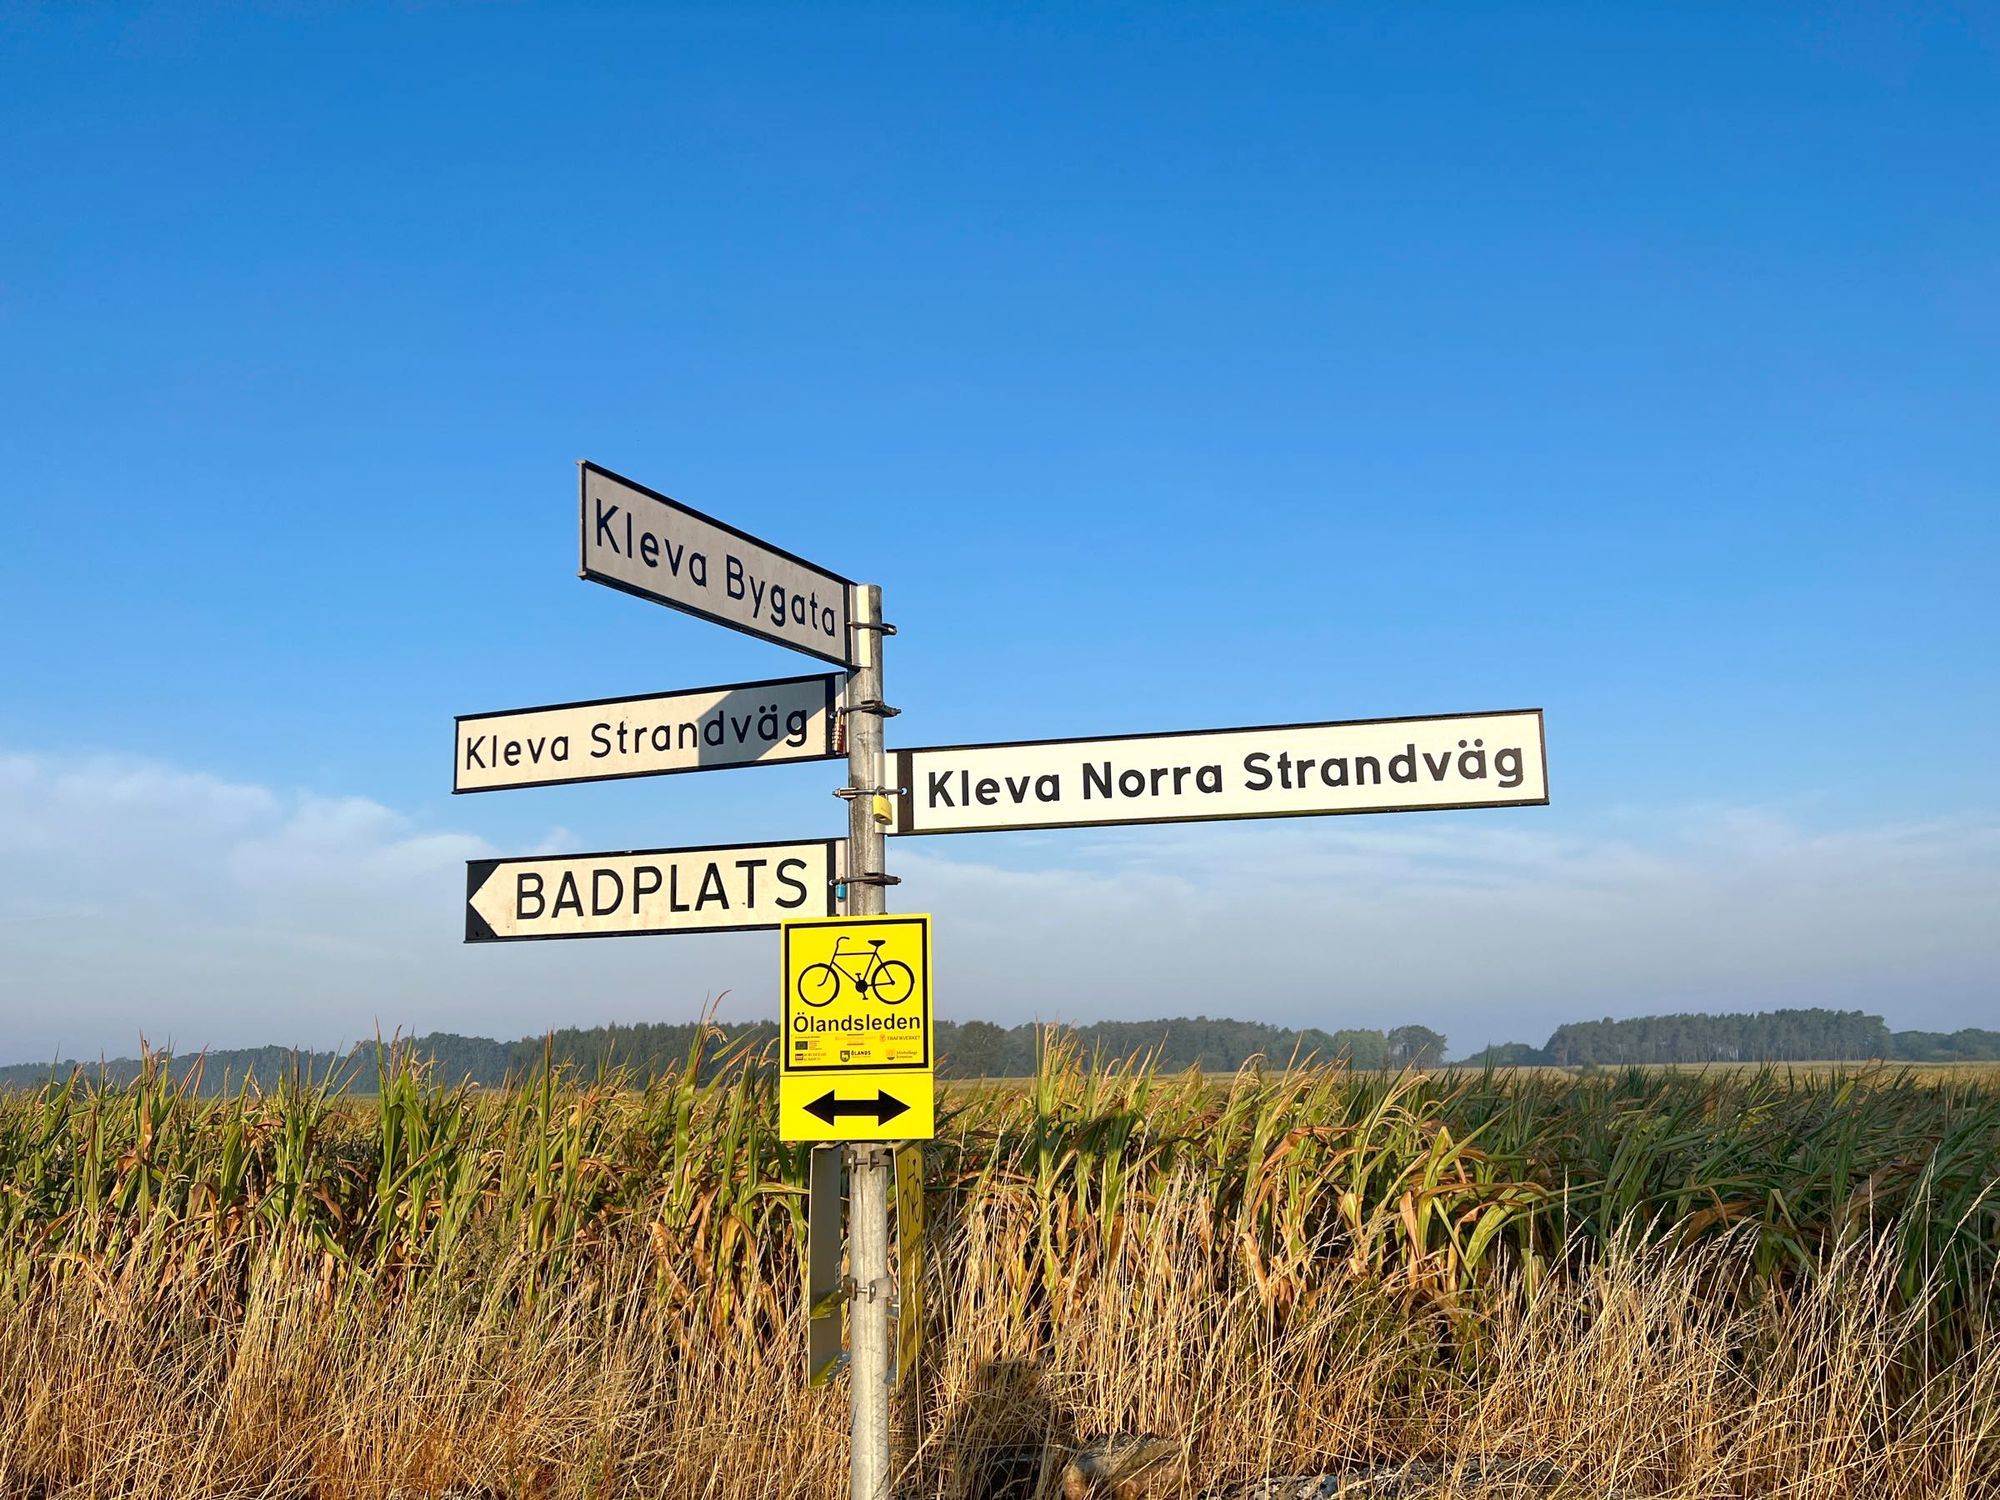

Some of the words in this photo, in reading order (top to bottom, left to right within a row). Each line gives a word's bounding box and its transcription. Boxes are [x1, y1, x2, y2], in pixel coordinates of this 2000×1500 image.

[596, 498, 708, 588] Kleva
[726, 554, 836, 637] Bygata
[466, 734, 569, 770] Kleva
[590, 704, 808, 758] Strandväg
[928, 770, 1061, 808] Kleva
[1082, 761, 1222, 799] Norra
[1244, 739, 1524, 790] Strandväg
[516, 858, 808, 920] BADPLATS
[794, 1012, 921, 1032] Ölandsleden
